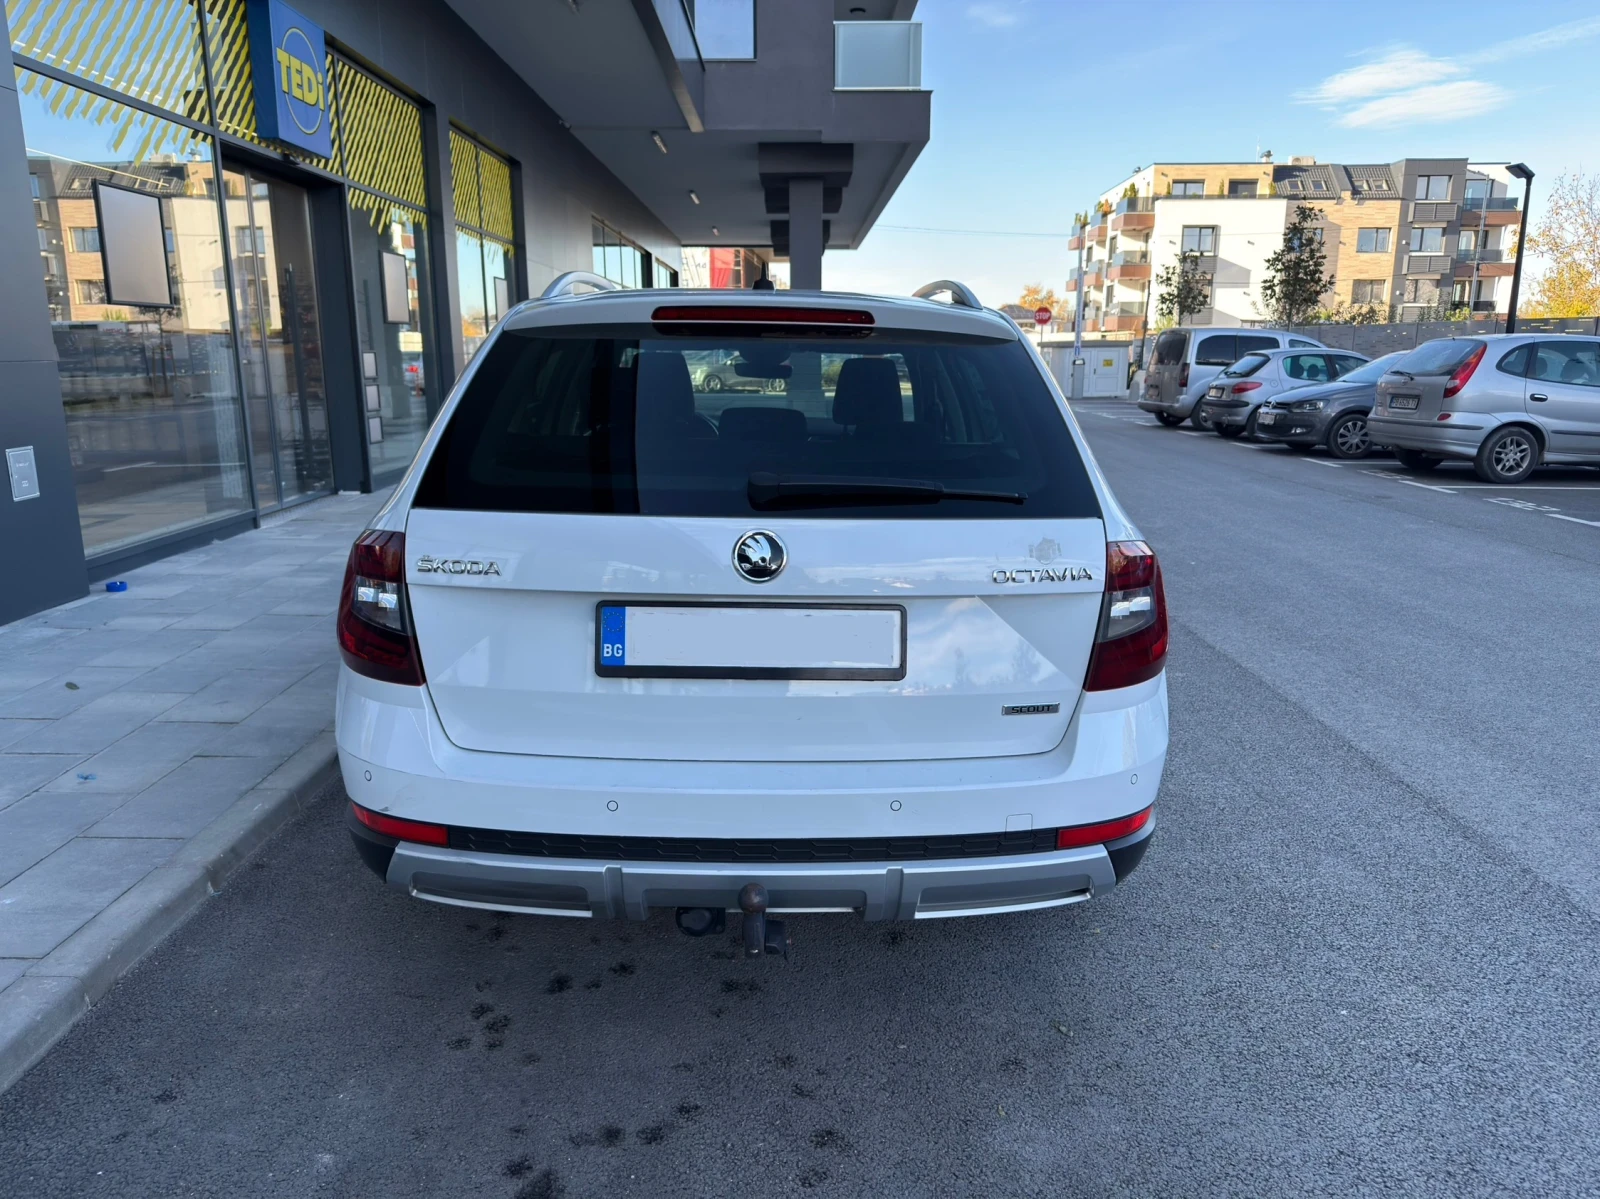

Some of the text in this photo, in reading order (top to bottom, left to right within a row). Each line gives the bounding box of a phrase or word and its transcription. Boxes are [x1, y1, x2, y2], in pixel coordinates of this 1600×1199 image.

[277, 48, 325, 111] TEDi
[1035, 312, 1050, 320] STOP
[417, 555, 503, 576] ŠKODA
[992, 567, 1093, 584] OCTAVIA
[603, 644, 622, 657] BG
[1011, 704, 1053, 714] SCOUT
